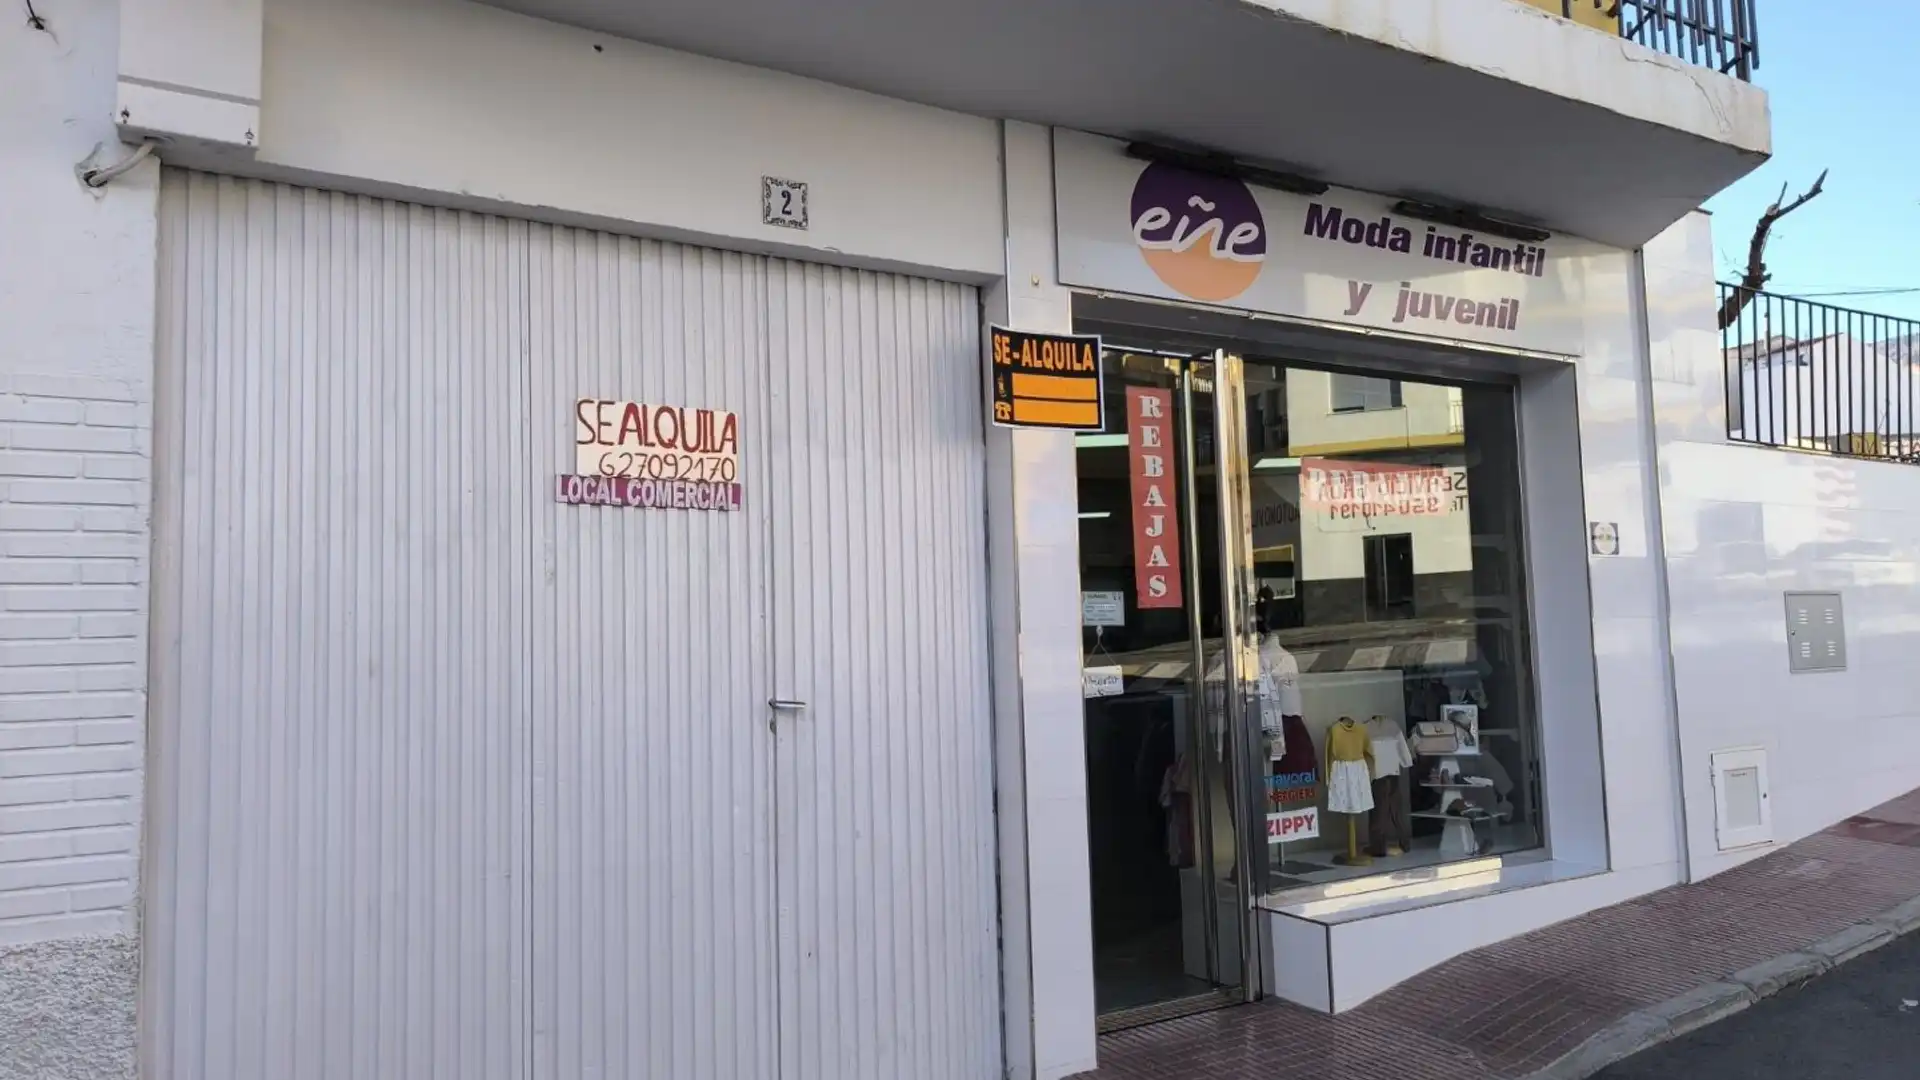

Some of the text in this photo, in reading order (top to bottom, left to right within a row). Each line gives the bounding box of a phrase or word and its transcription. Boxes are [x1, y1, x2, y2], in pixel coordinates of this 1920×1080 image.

[781, 190, 792, 215] 2
[1132, 195, 1266, 262] eñe
[1304, 203, 1546, 277] Moda infantil
[1343, 280, 1520, 330] y juvenil
[618, 403, 738, 455] ALQUILA
[599, 452, 736, 482] 627092170
[556, 475, 739, 511] LOCAL COMERCIAL
[1138, 395, 1170, 598] REBAJAS
[1267, 814, 1314, 836] ZIPPY
